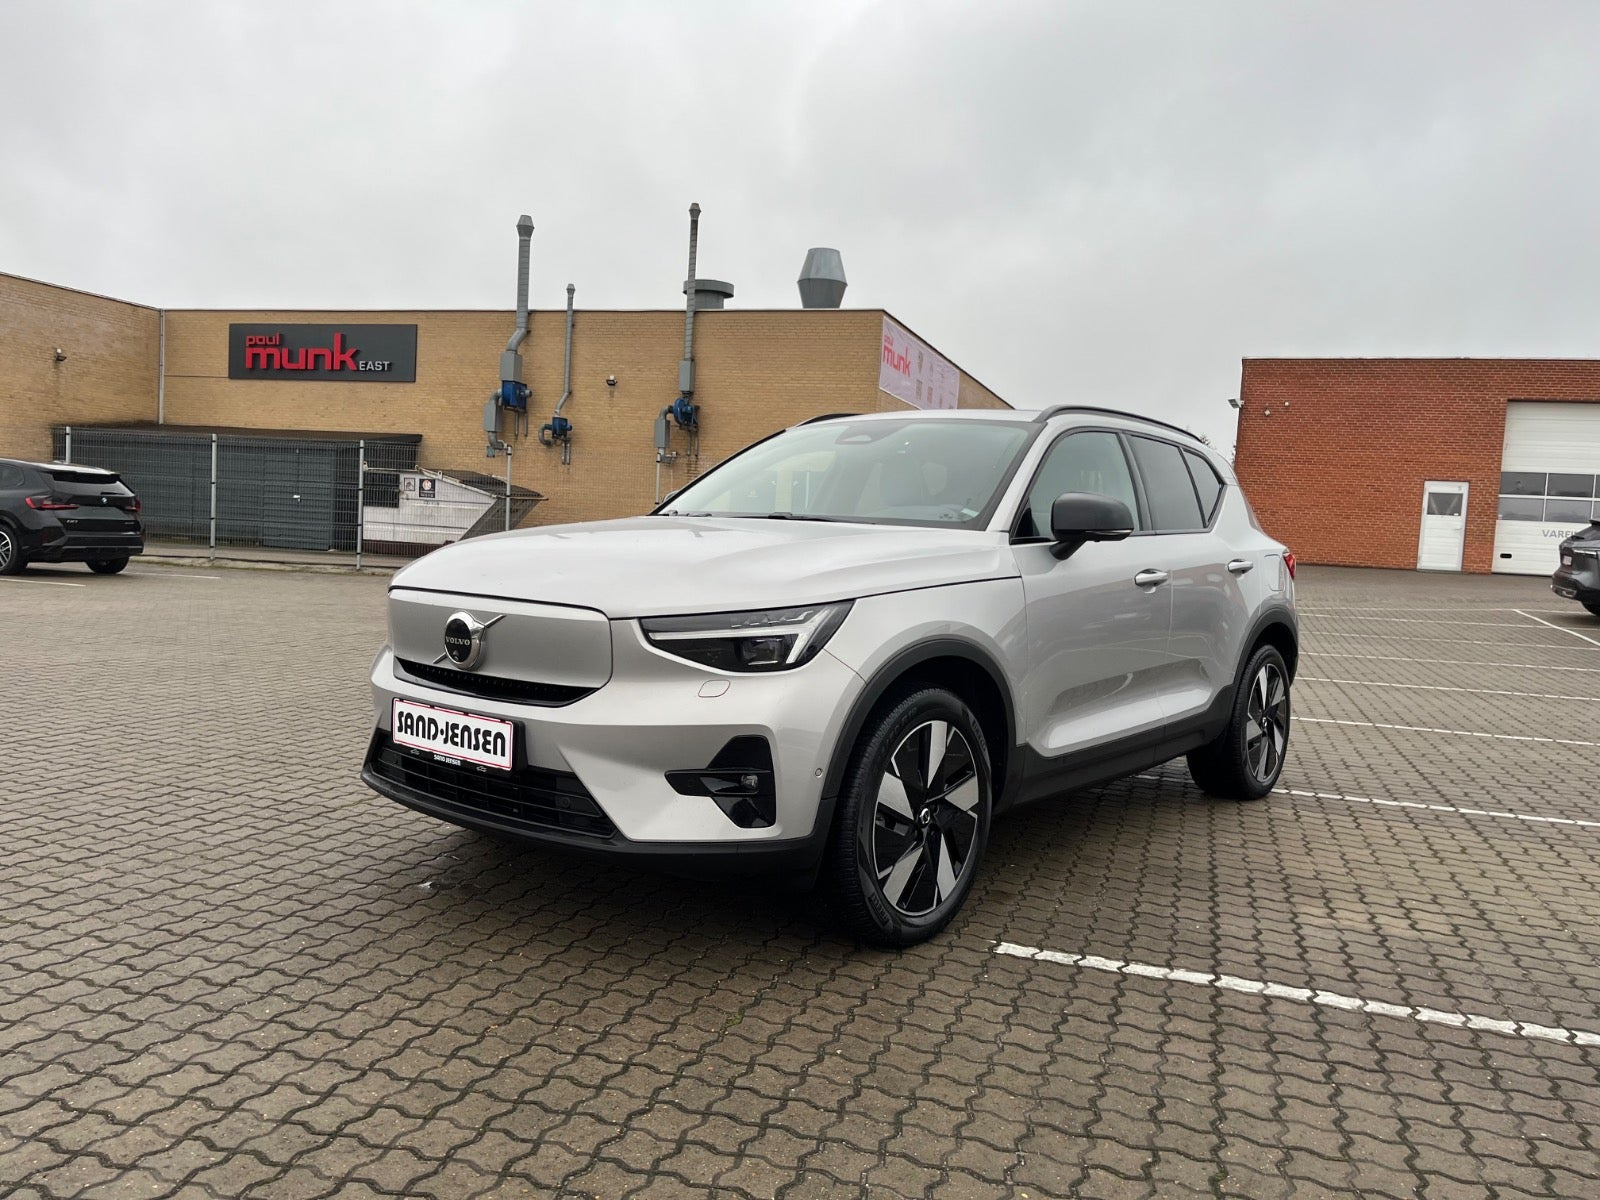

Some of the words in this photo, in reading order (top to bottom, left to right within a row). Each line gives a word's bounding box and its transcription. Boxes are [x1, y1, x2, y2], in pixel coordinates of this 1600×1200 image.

[246, 332, 280, 346] paul
[245, 332, 358, 371] munk
[359, 360, 390, 371] EAST
[883, 344, 911, 377] munk
[445, 636, 470, 646] VOLVO
